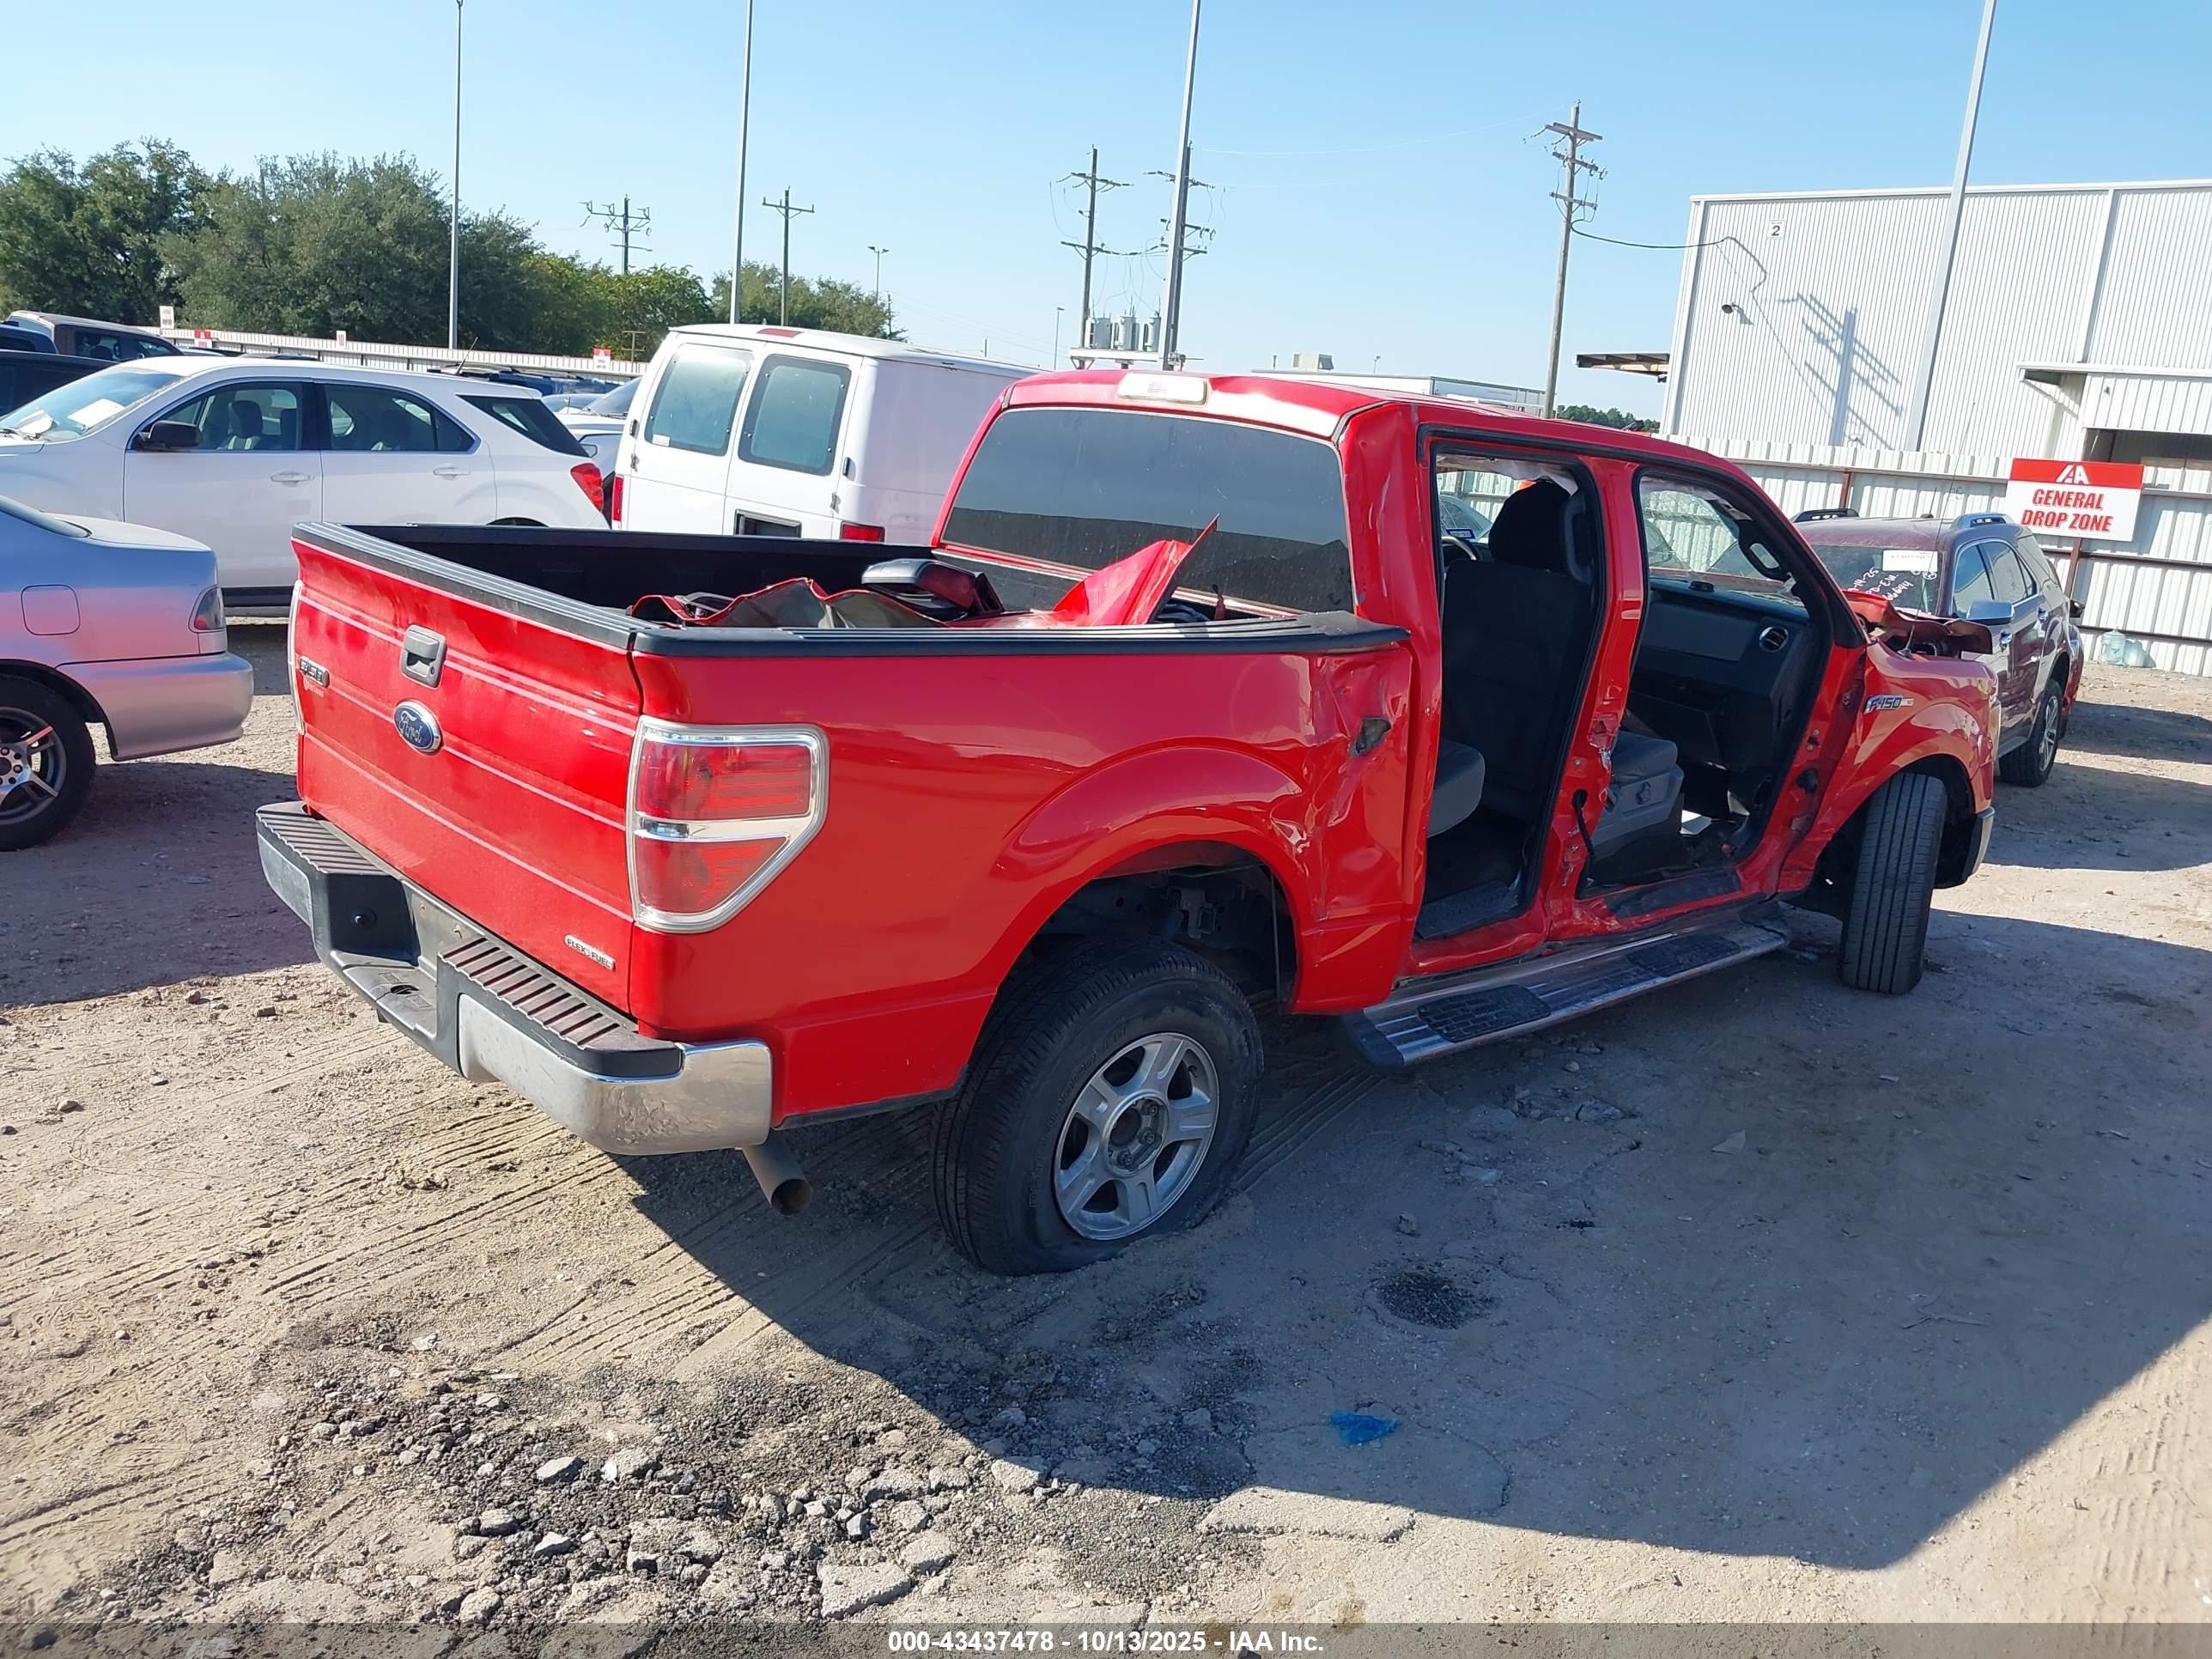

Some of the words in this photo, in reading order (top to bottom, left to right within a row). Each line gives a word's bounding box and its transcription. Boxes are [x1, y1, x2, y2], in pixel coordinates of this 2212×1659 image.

[1771, 225, 1781, 236] 2
[2033, 489, 2105, 511] GENERAL
[2021, 509, 2069, 528] DROP
[2069, 514, 2113, 532] ZONE
[398, 710, 425, 744] Ford
[567, 938, 586, 954] FLEX
[592, 951, 612, 969] FUEL
